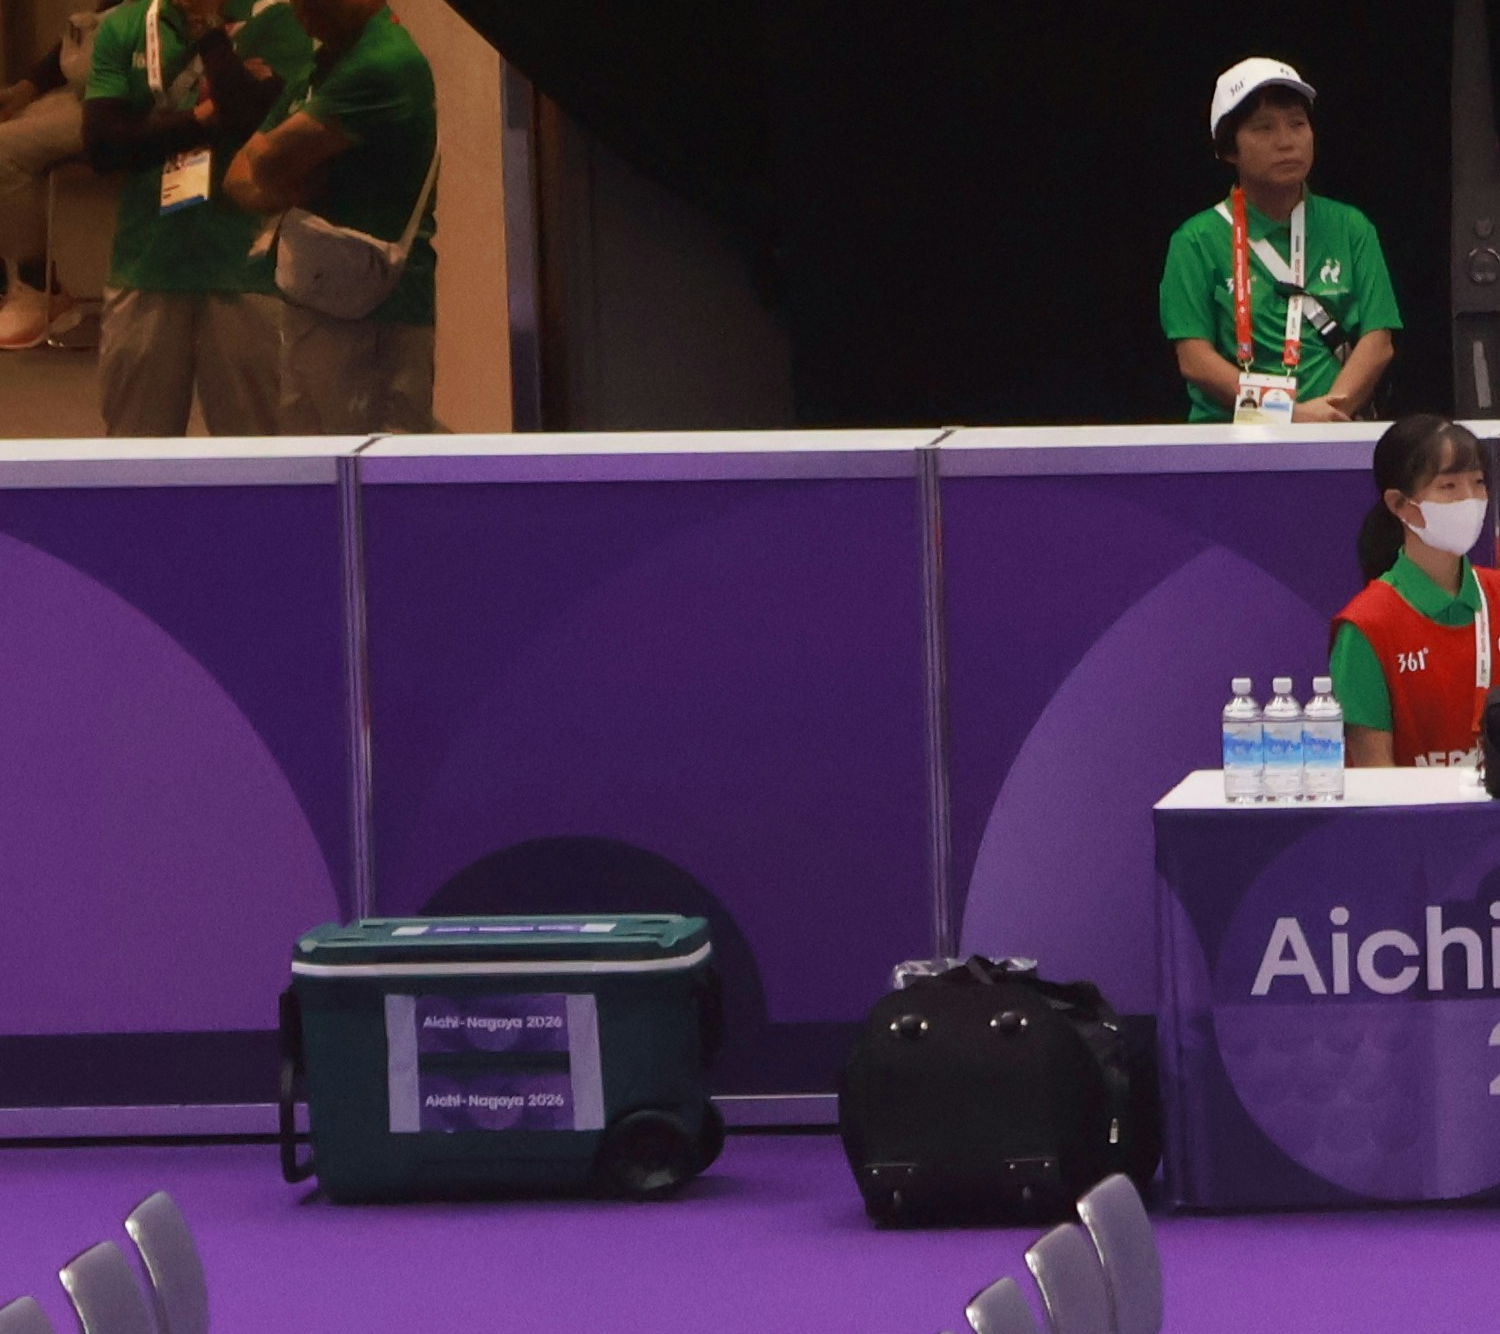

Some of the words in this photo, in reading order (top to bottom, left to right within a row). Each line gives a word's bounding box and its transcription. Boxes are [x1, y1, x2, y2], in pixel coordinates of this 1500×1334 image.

[423, 1016, 523, 1032] Aichi-Nagoya
[526, 1016, 563, 1029] 2026
[425, 1094, 525, 1110] Aichi-Nagoya
[528, 1093, 565, 1107] 2026
